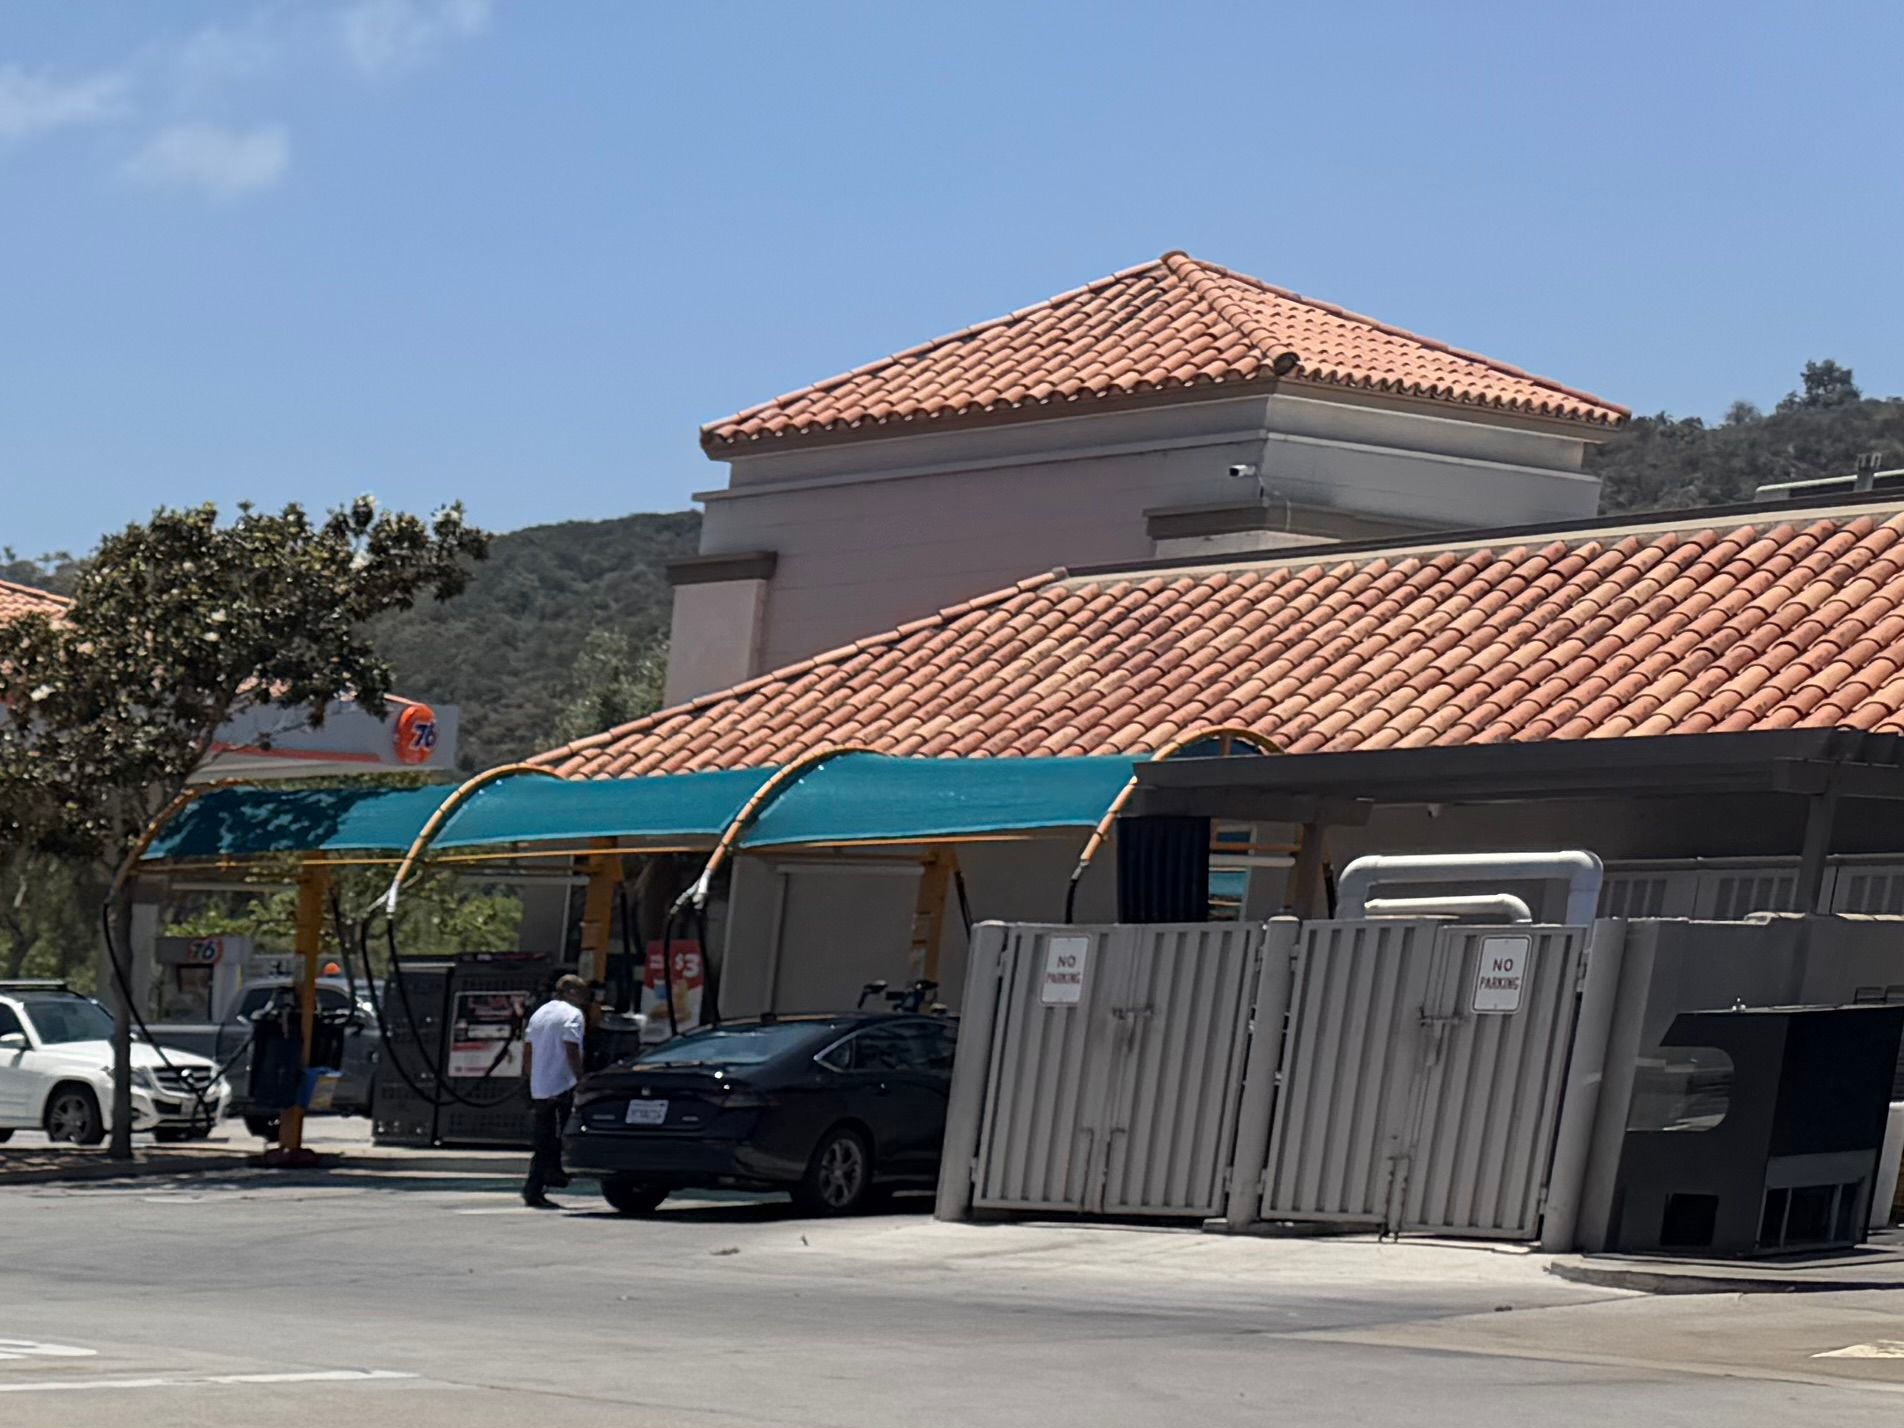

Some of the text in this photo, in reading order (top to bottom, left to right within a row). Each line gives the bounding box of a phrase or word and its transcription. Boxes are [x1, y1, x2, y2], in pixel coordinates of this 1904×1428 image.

[414, 722, 437, 748] 76
[193, 939, 216, 959] 76
[675, 953, 699, 977] $3
[1056, 955, 1076, 968] NO
[1493, 958, 1514, 972] NO
[1047, 972, 1081, 984] PARKING
[1479, 976, 1520, 991] PARKING
